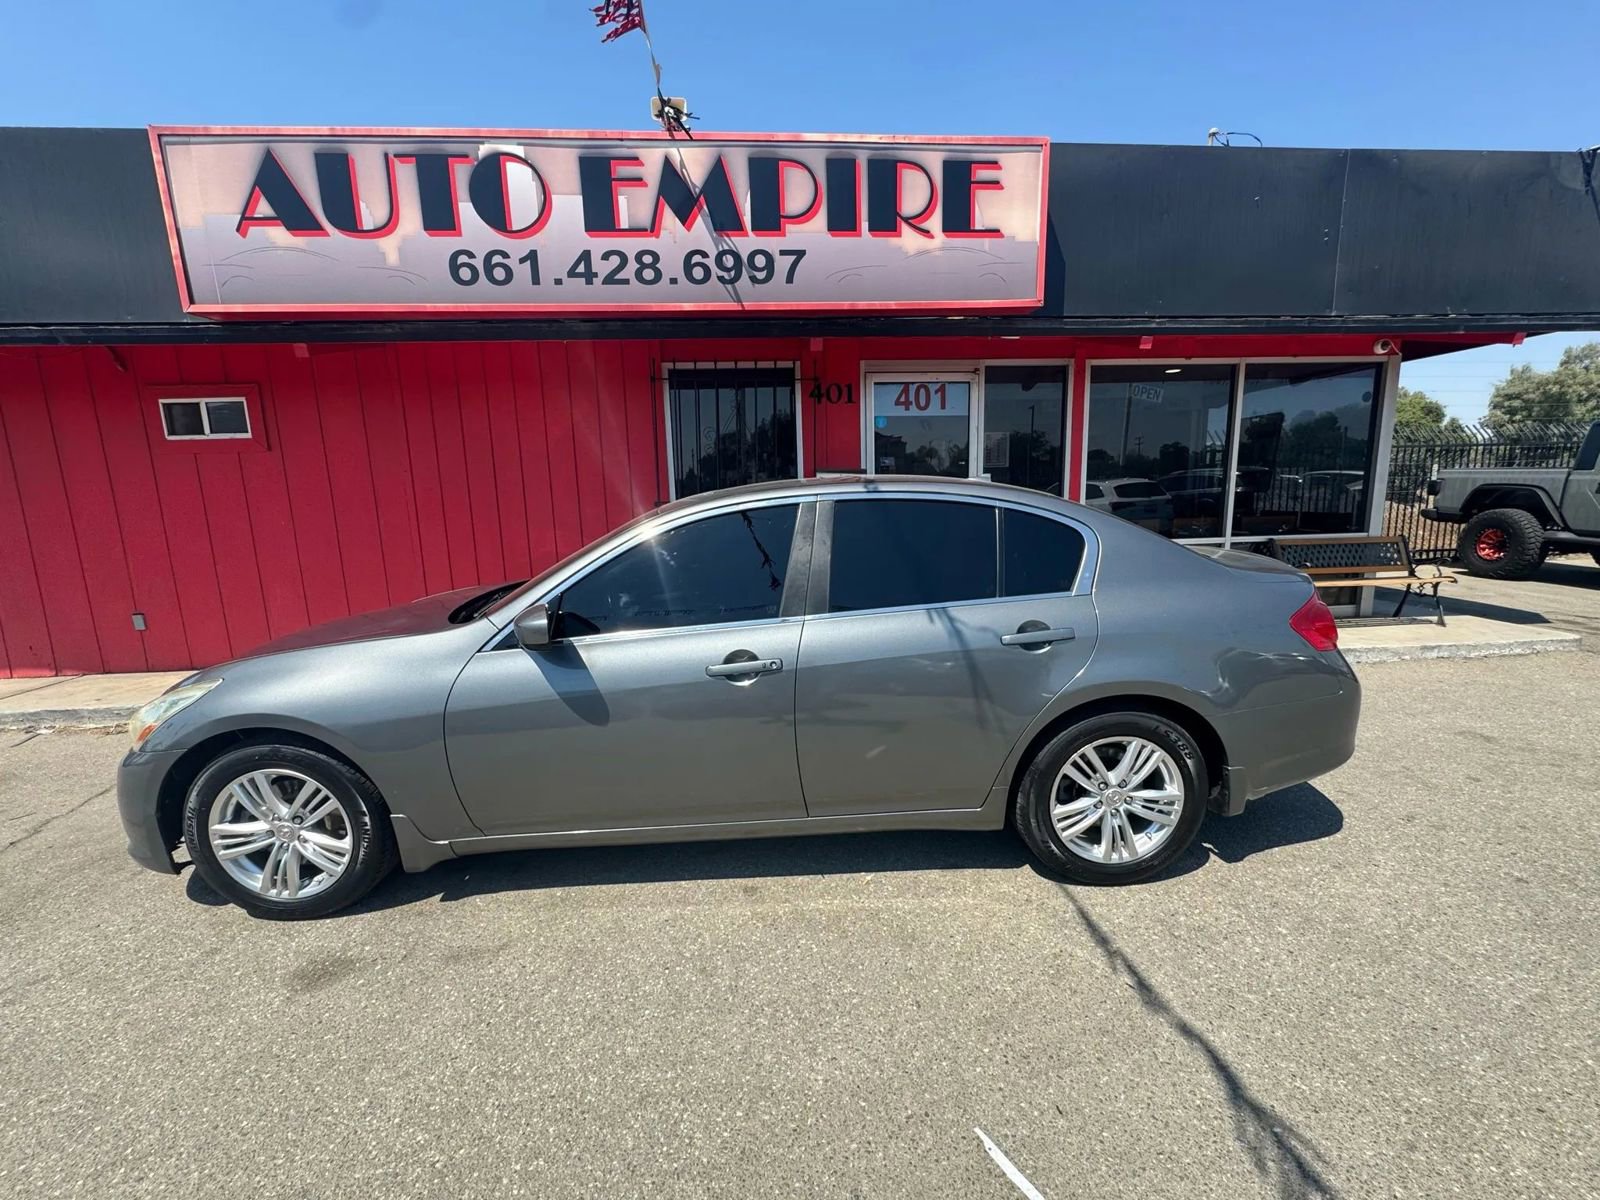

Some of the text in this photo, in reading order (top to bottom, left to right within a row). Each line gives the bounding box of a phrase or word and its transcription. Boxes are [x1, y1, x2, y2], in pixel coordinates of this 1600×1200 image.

[236, 147, 1005, 239] AUTO EMPIRE
[448, 248, 807, 287] 661.428.6997
[809, 382, 856, 405] 401
[894, 382, 947, 411] 401
[1132, 384, 1161, 401] OPEN
